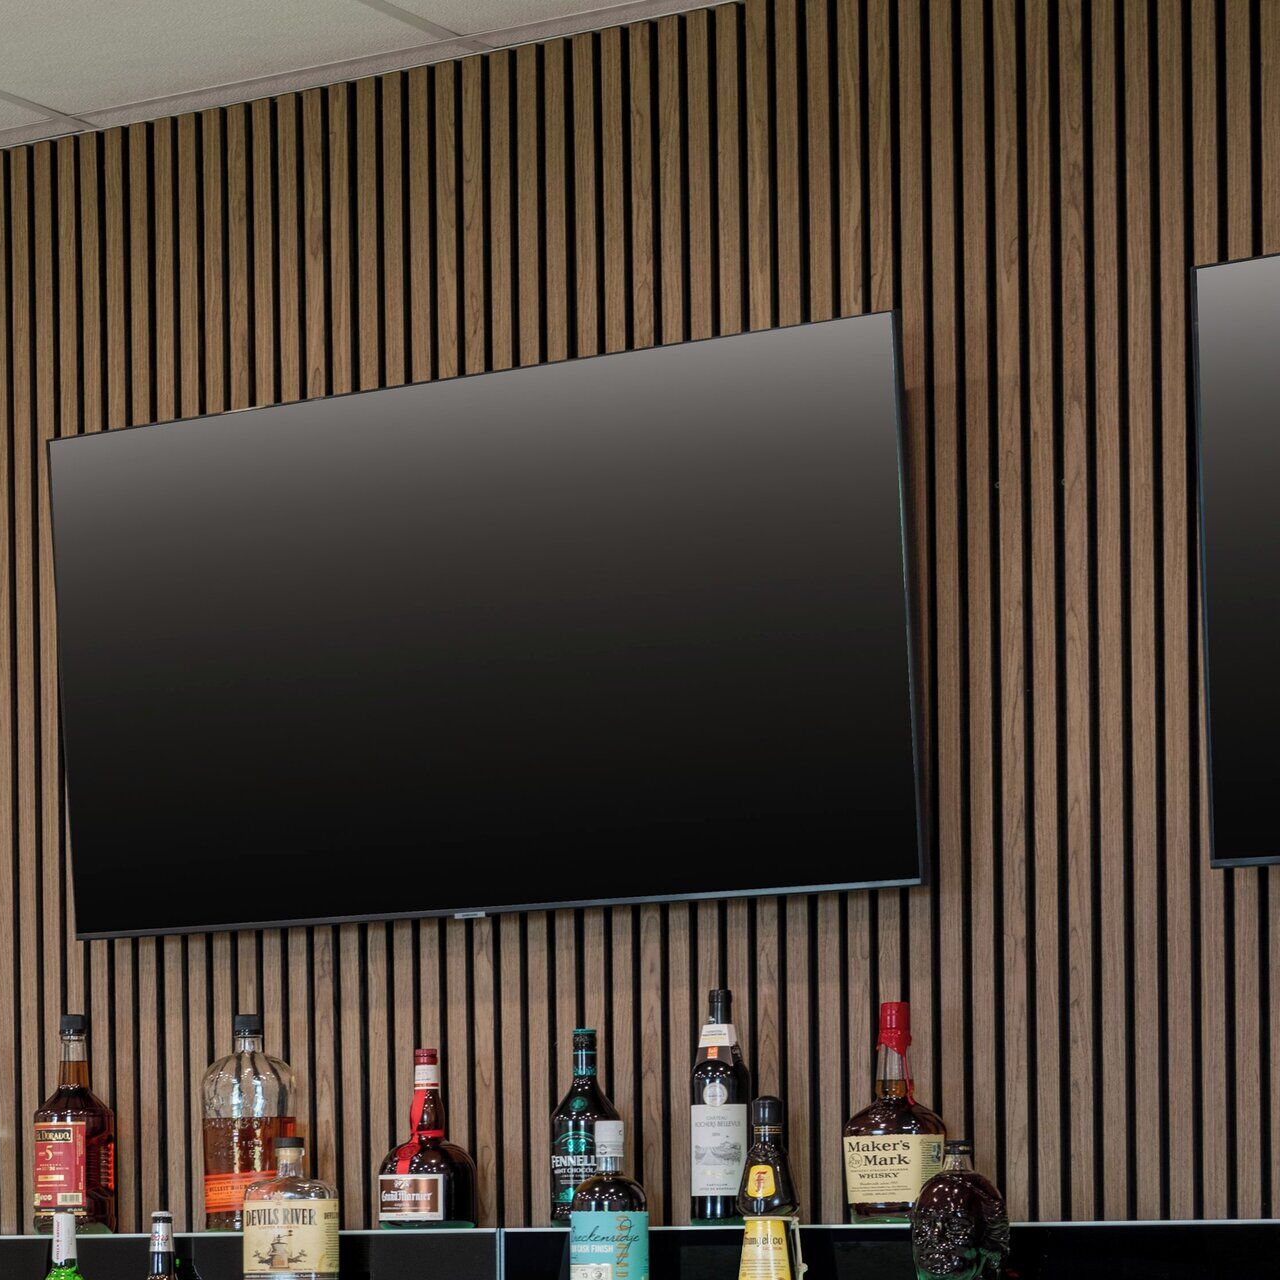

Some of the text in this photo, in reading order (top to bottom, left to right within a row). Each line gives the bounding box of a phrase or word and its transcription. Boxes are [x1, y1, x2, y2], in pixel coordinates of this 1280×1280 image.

[42, 1130, 70, 1140] DORADO
[45, 1145, 53, 1160] 5
[847, 1140, 910, 1153] Maker's
[551, 1155, 597, 1168] FENNELL
[863, 1154, 910, 1166] Mark
[245, 1207, 317, 1226] DEVILS RIVER
[571, 1218, 640, 1265] reckenridge
